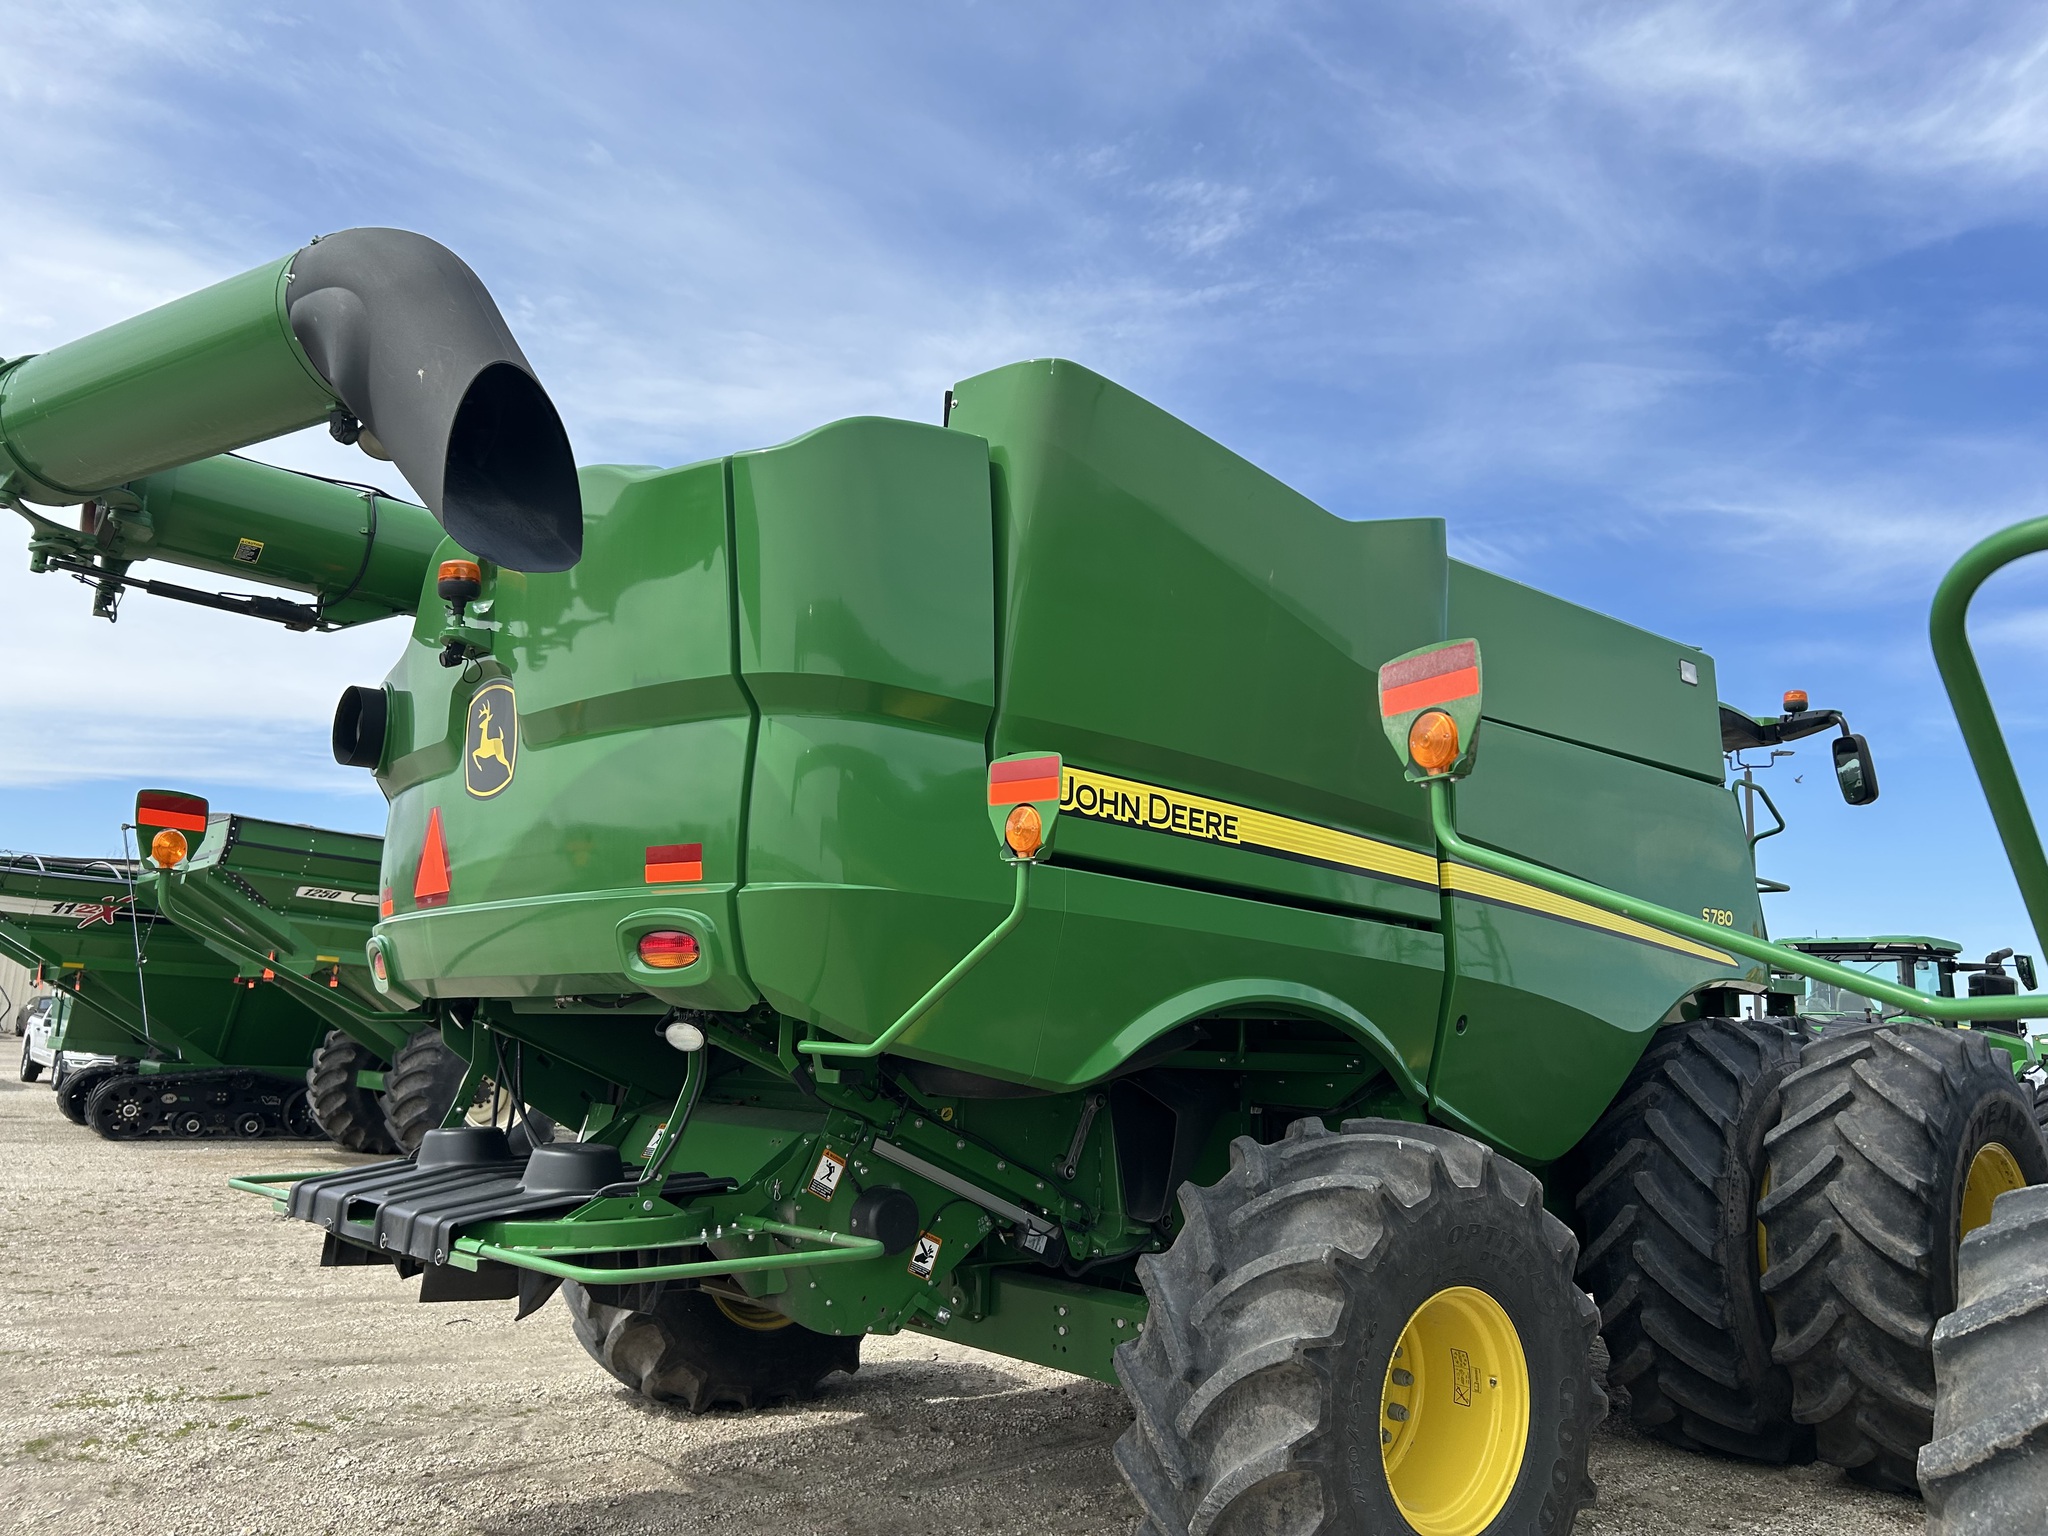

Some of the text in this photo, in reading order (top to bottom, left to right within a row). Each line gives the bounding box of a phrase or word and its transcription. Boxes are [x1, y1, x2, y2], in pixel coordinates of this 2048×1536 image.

[1060, 776, 1238, 839] JOHN DEERE
[303, 888, 342, 899] 1250
[1703, 908, 1733, 926] S780
